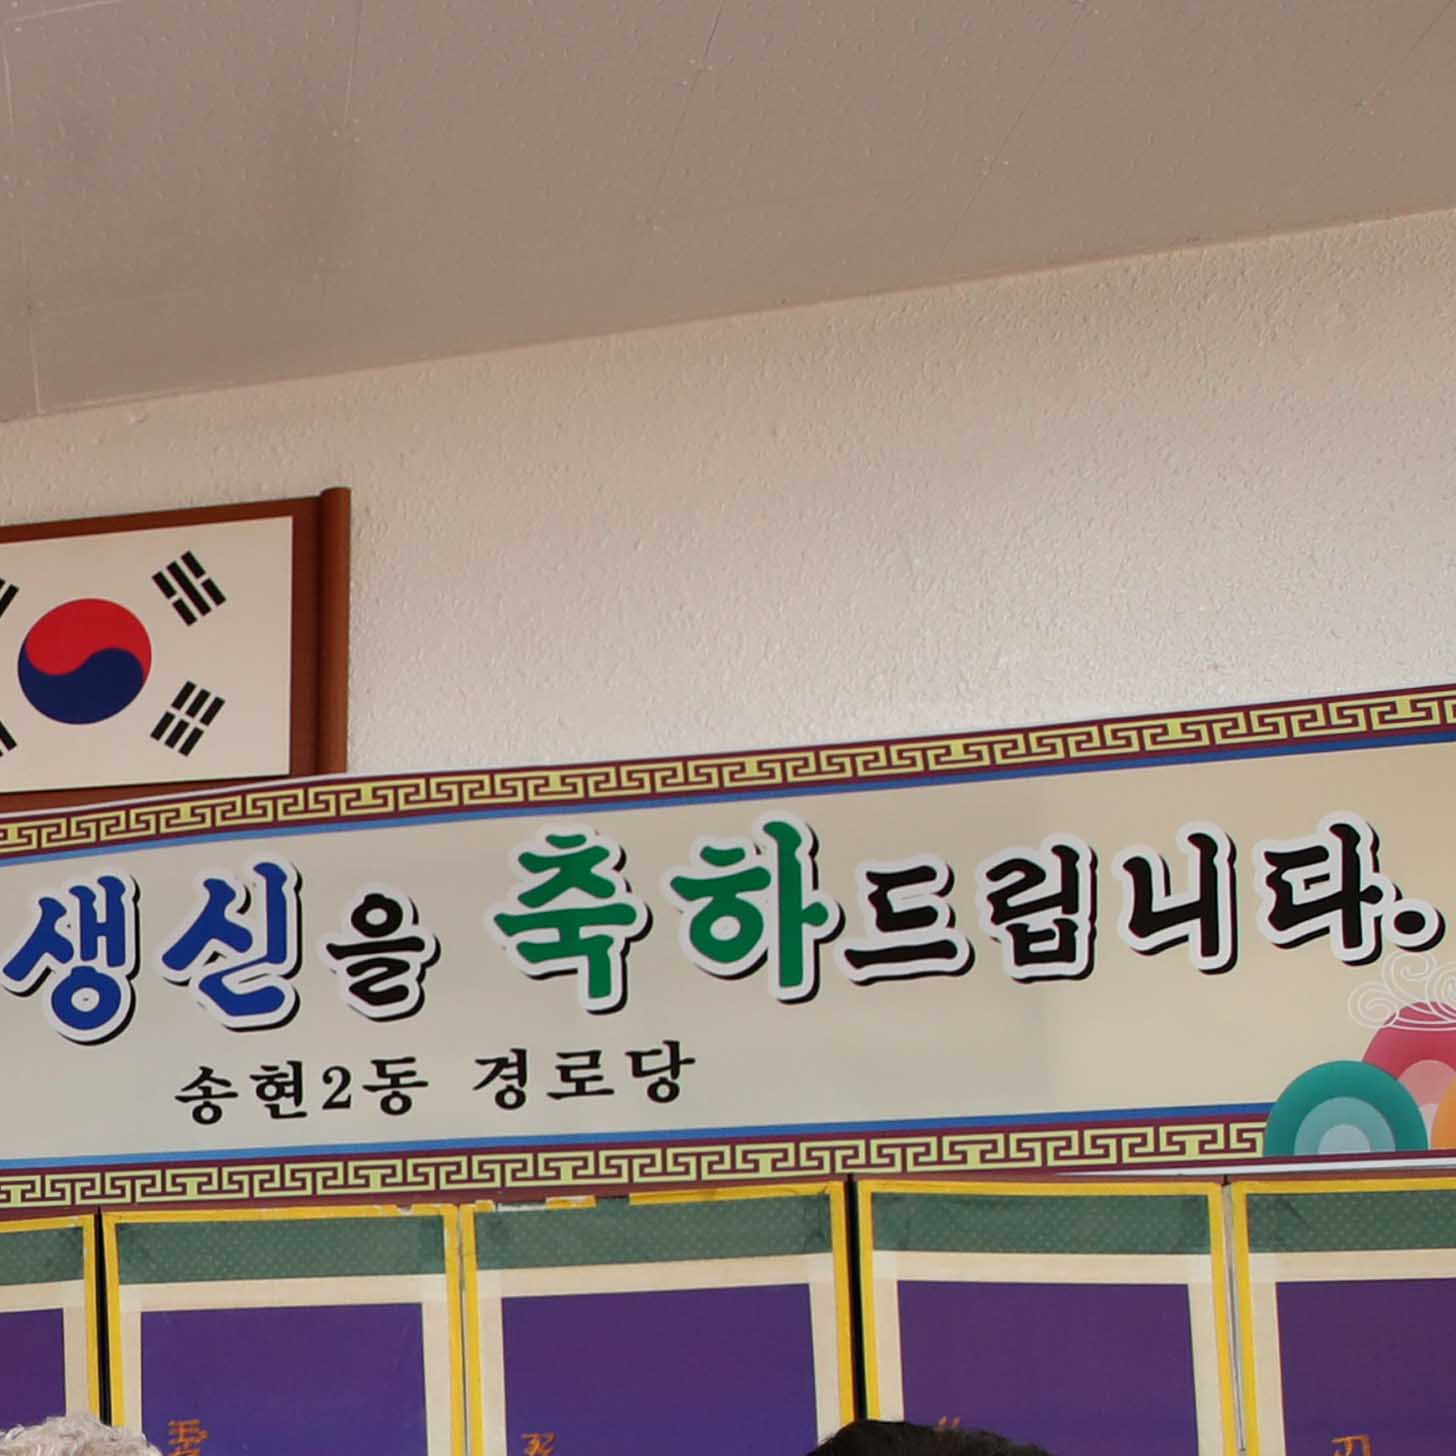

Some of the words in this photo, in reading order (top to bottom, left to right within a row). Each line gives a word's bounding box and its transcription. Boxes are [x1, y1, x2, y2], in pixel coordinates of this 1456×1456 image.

[0, 861, 429, 1032] 생신을
[492, 819, 1428, 1001] 축하드립니다.
[173, 1055, 430, 1126] 송현2동
[472, 1039, 697, 1111] 경로당
